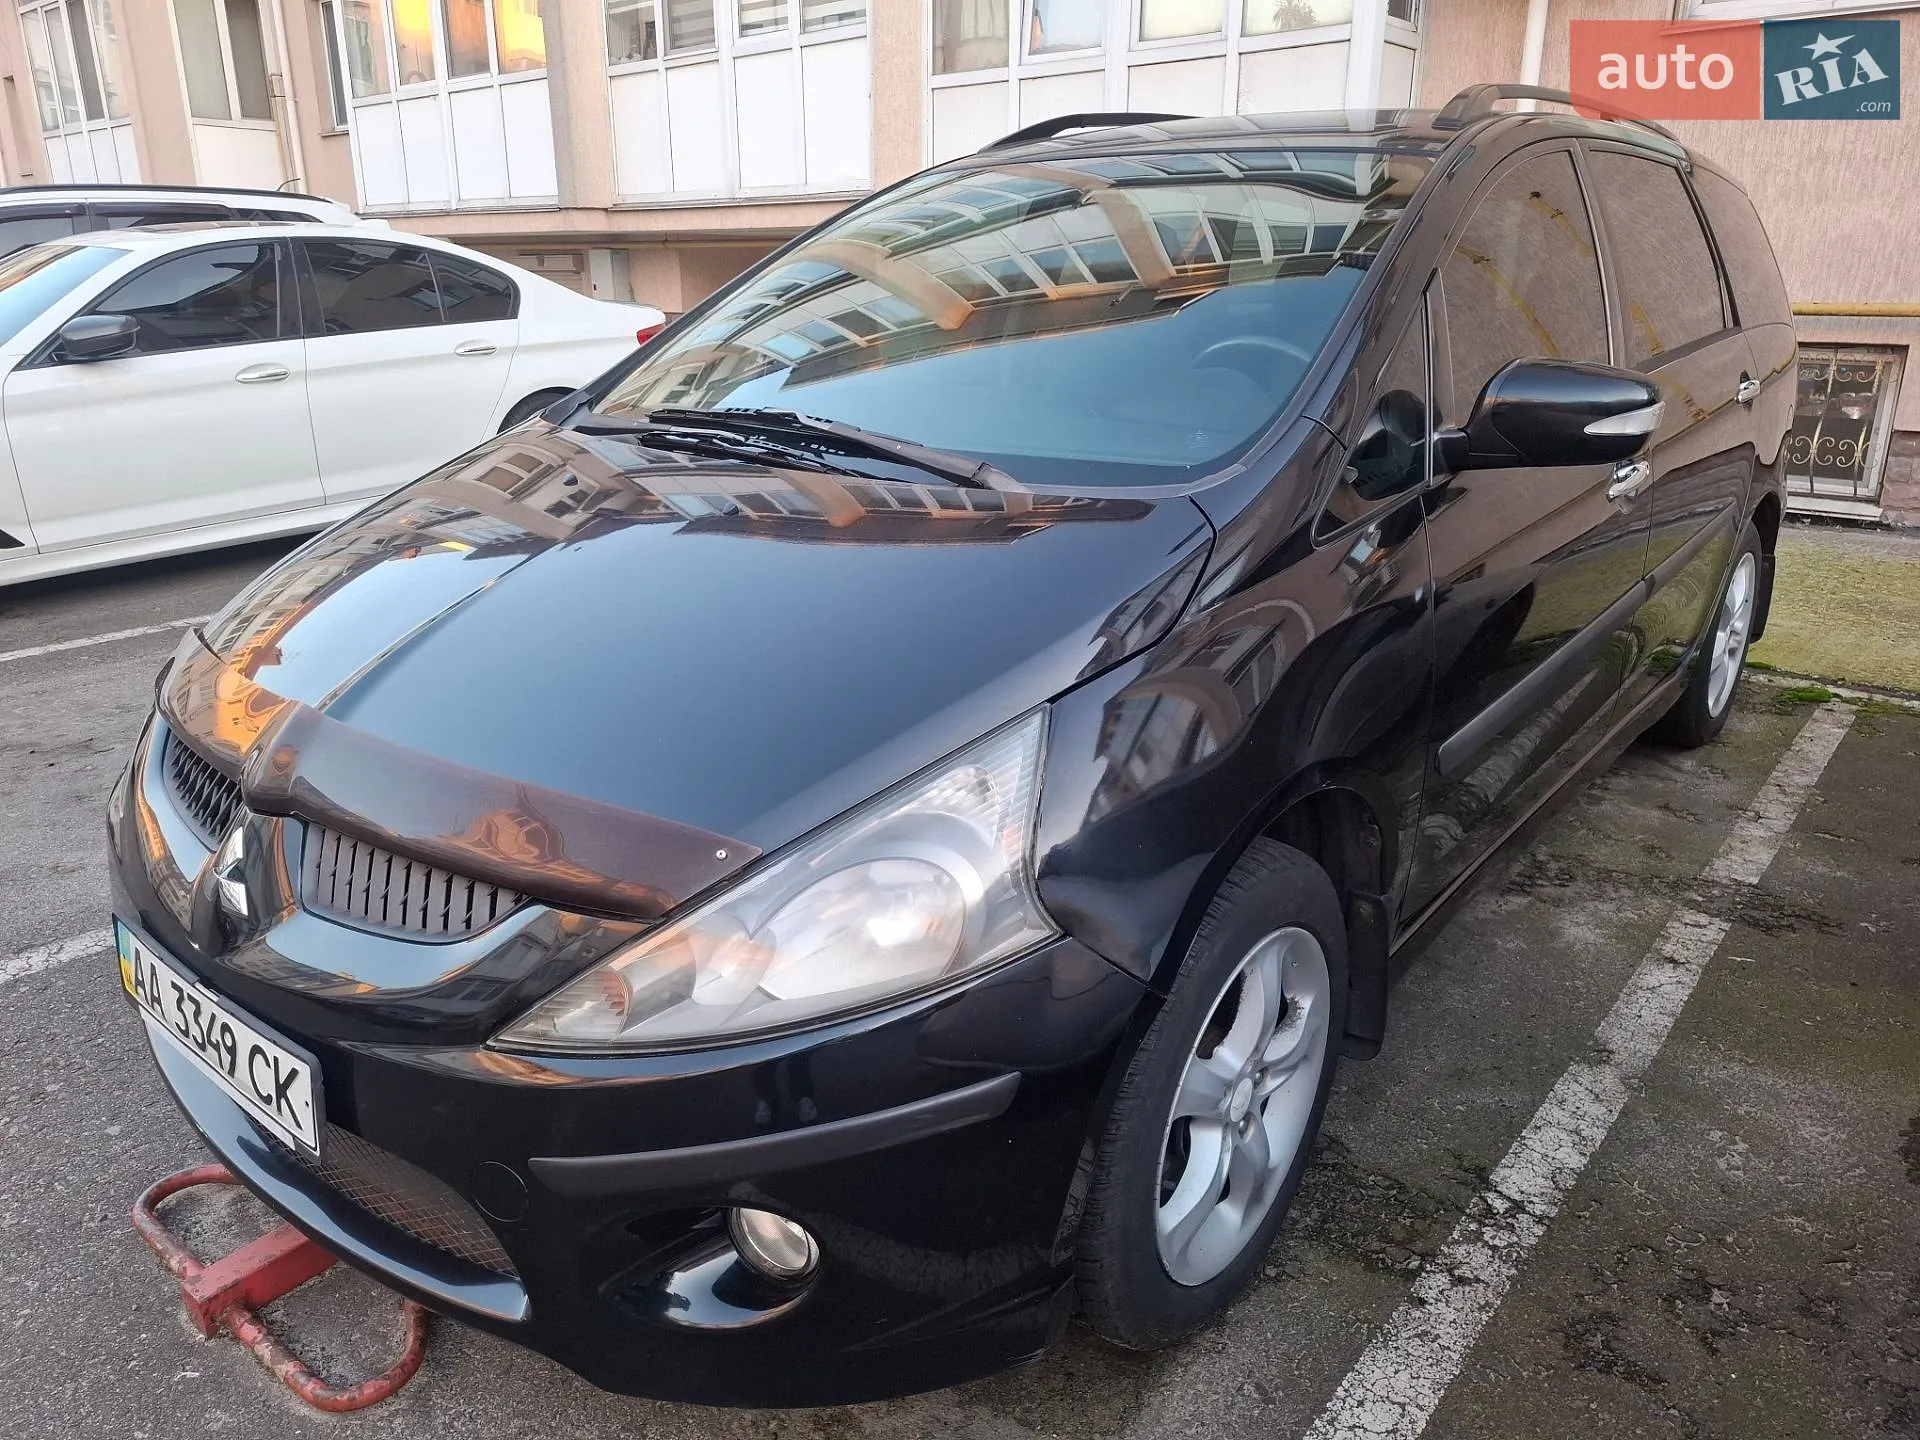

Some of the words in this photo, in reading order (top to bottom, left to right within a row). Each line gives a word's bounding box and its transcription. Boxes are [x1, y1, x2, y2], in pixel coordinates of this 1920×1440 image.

[134, 946, 168, 1023] AA
[171, 980, 238, 1079] 3349
[248, 1043, 303, 1131] CK
